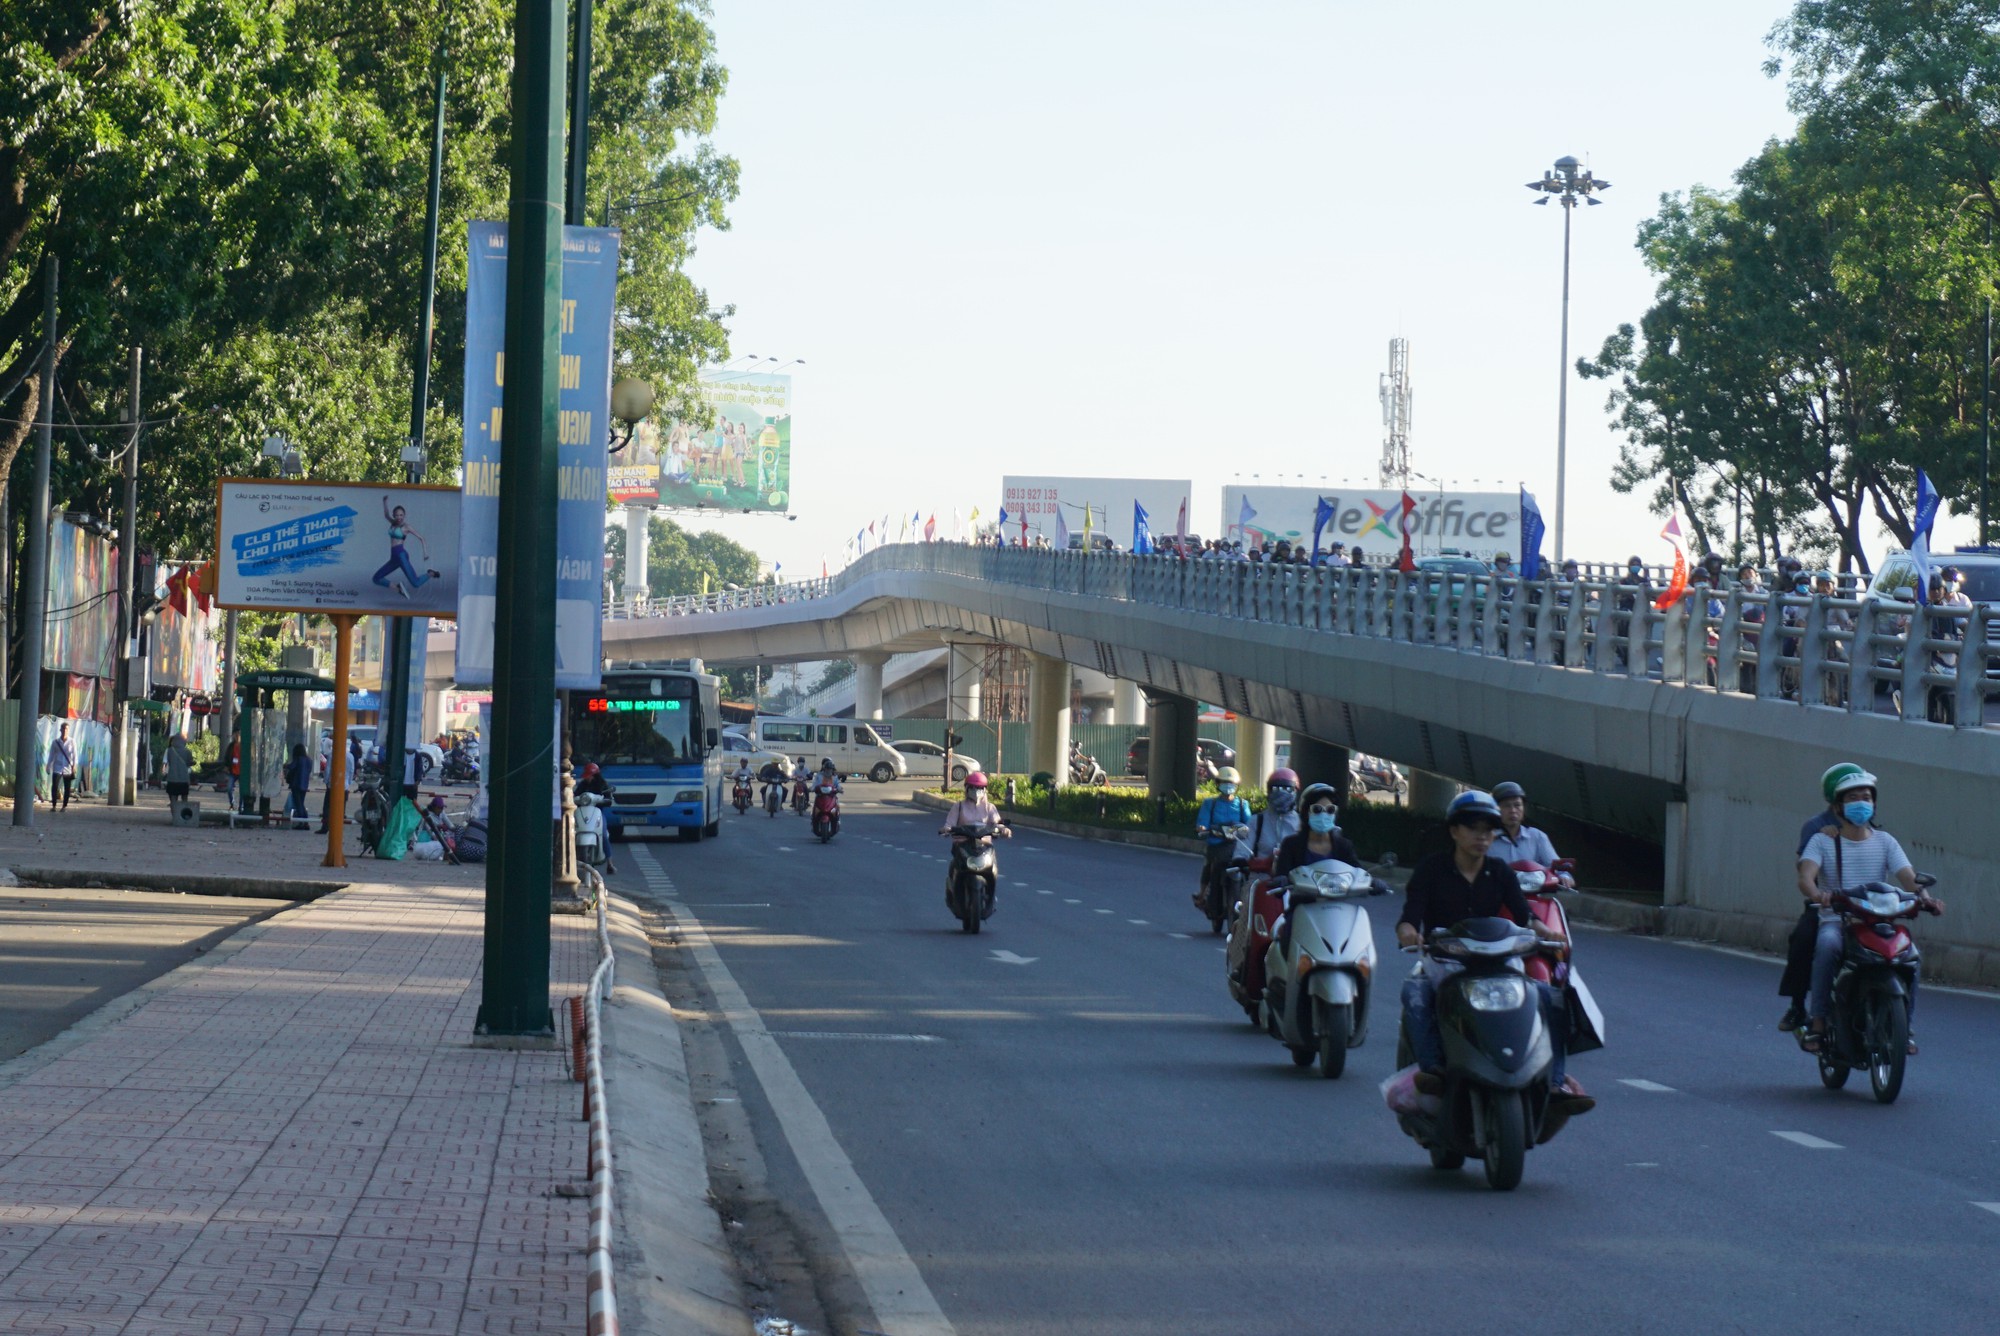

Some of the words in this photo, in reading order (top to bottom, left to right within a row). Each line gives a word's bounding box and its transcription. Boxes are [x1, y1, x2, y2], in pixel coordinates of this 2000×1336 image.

[1006, 488, 1025, 499] 0913
[1027, 488, 1041, 499] 927
[1044, 489, 1058, 500] 135
[1027, 502, 1040, 513] 343
[1043, 502, 1057, 513] 180
[304, 516, 338, 534] THAO
[242, 545, 269, 560] CHO
